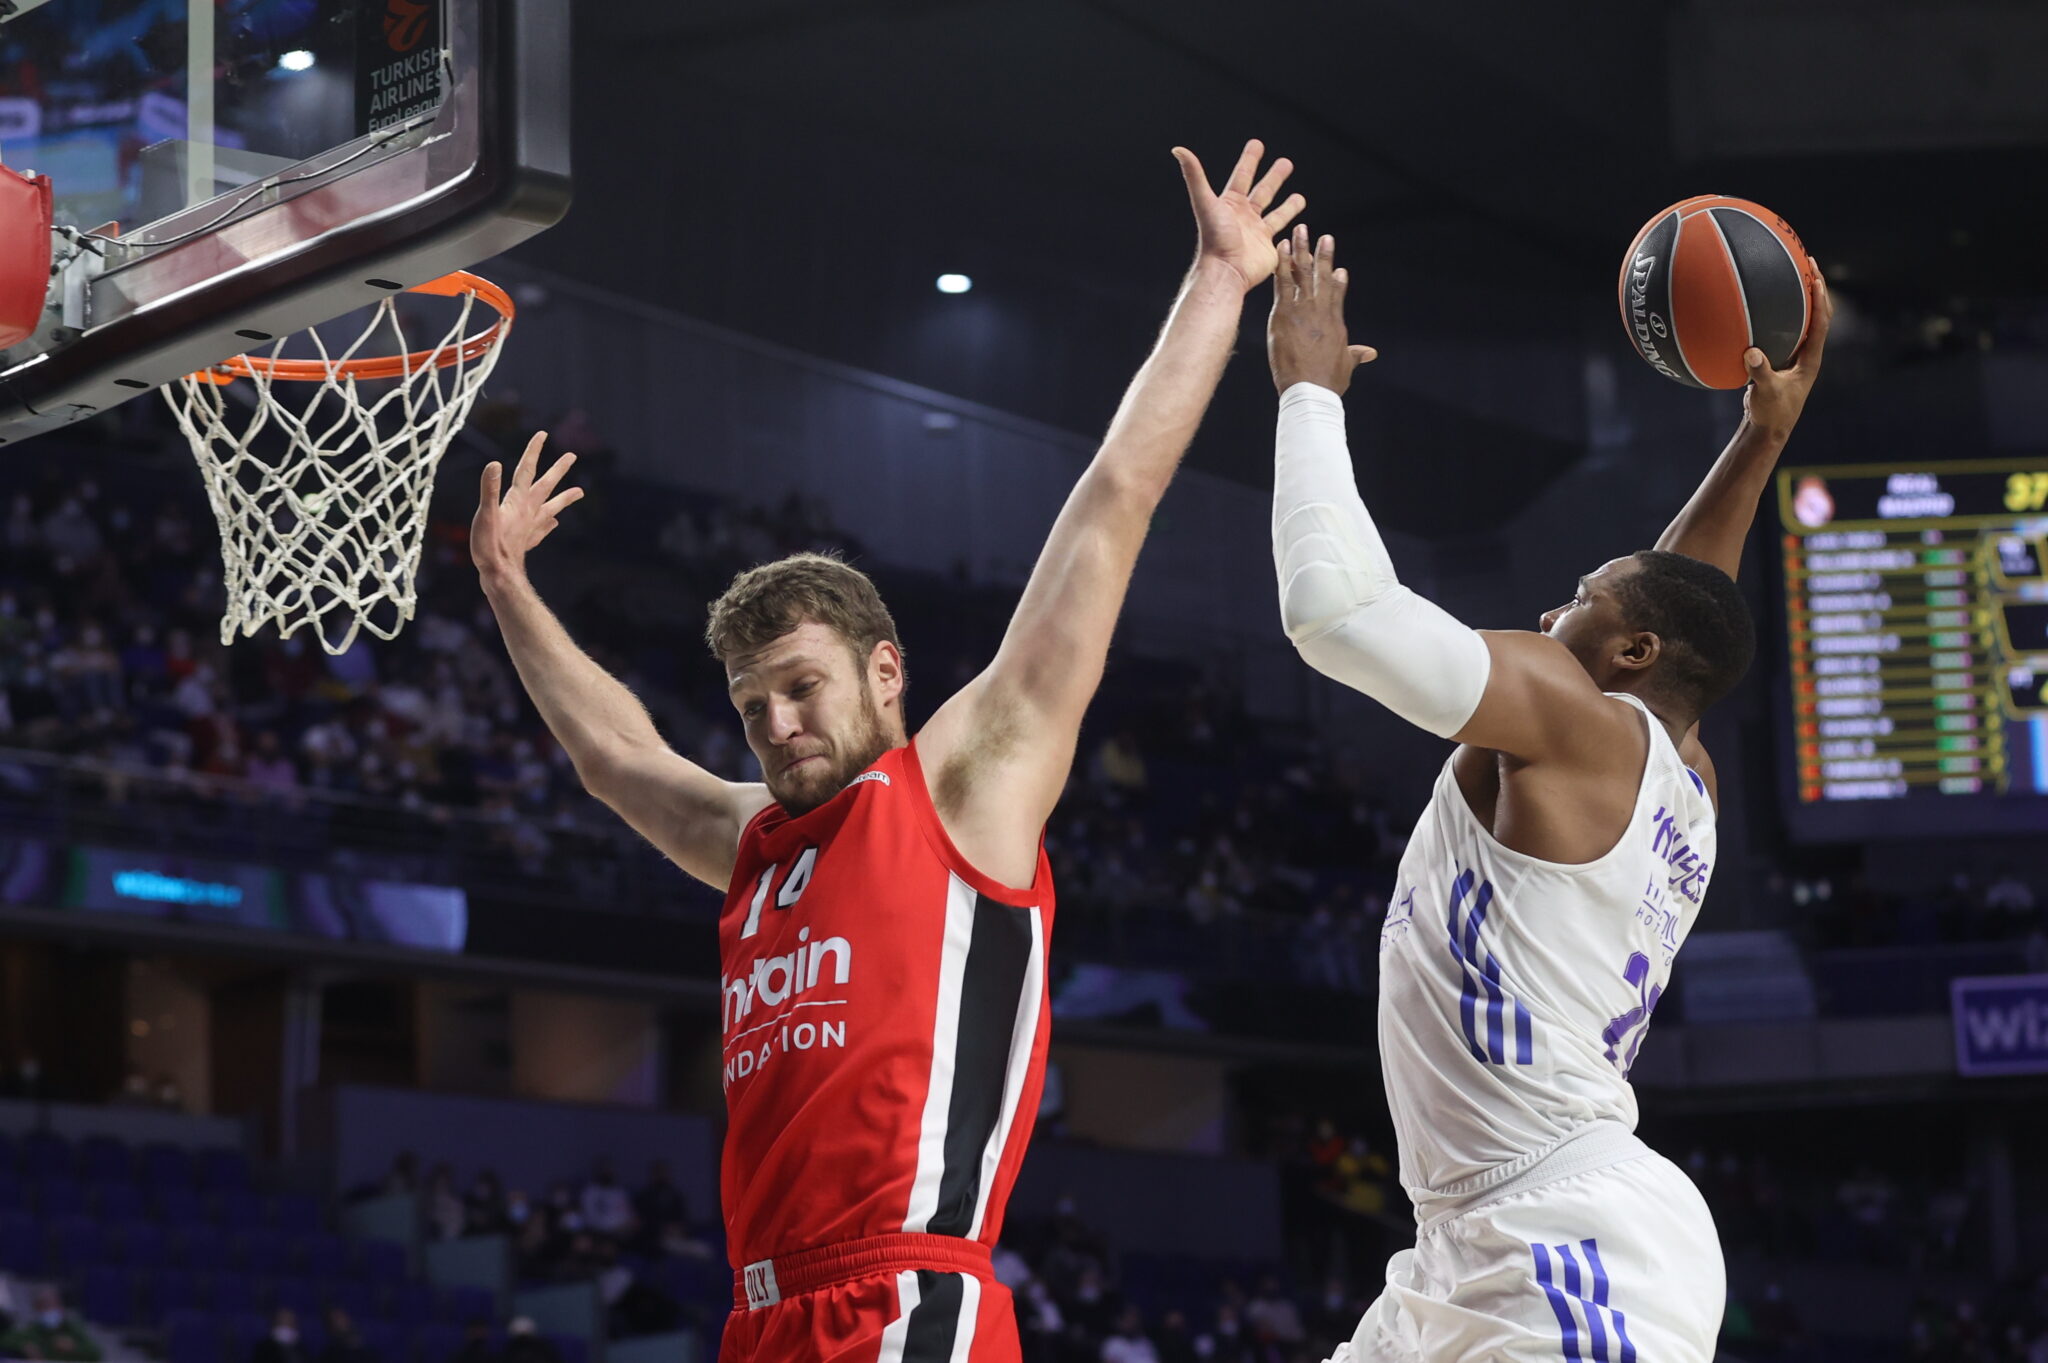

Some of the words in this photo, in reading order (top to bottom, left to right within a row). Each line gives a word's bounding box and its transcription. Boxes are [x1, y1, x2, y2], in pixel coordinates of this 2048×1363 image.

[1631, 253, 1681, 379] SPALDING
[740, 847, 818, 940] 14
[722, 926, 851, 1034] hrain
